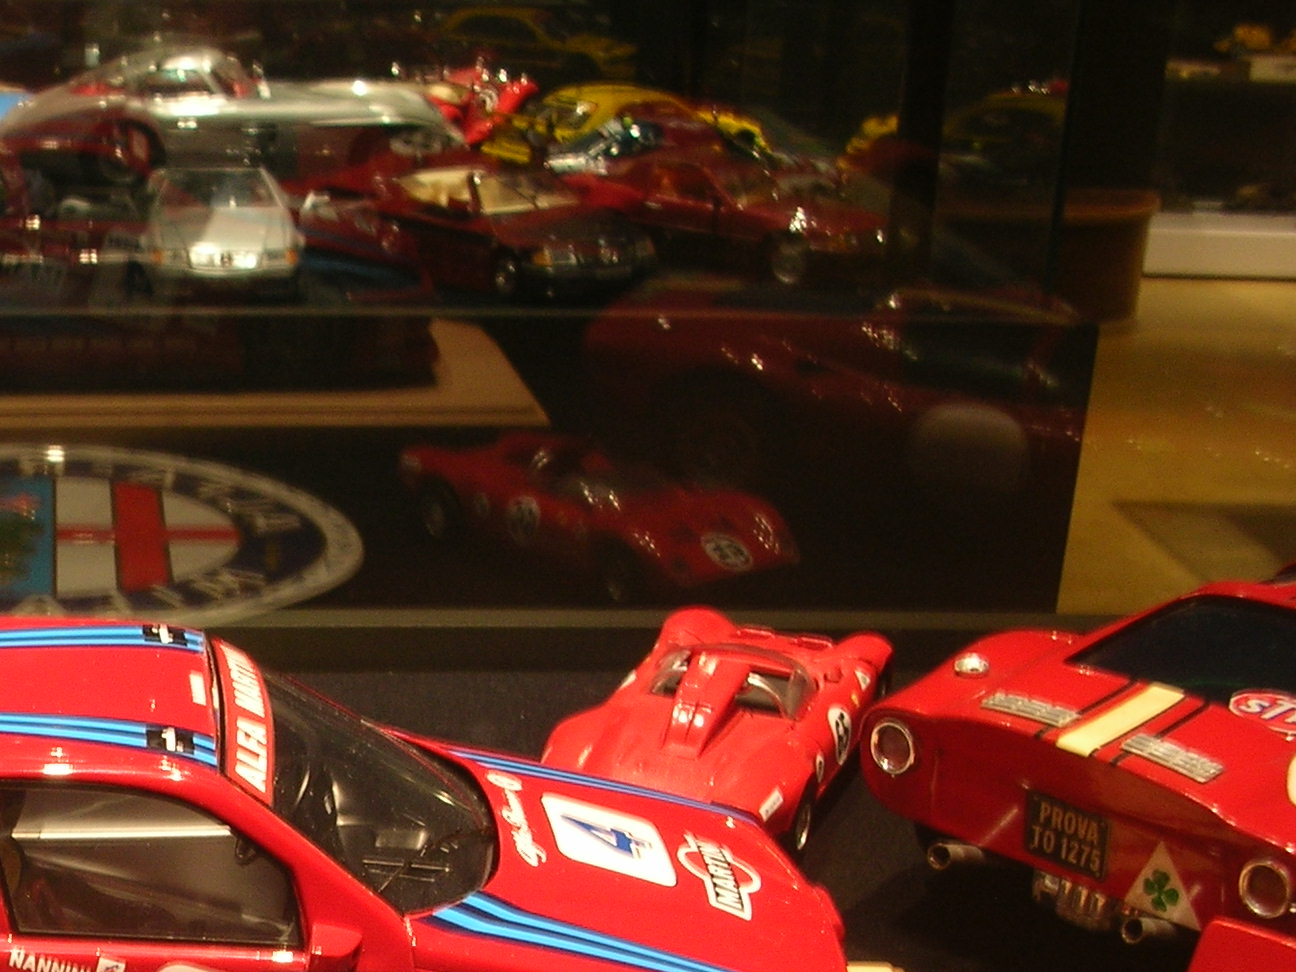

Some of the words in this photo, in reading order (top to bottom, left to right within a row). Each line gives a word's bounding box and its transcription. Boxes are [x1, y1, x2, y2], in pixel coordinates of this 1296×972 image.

[561, 813, 652, 860] 4
[1039, 801, 1099, 844] PROVA
[1061, 837, 1101, 872] 1275
